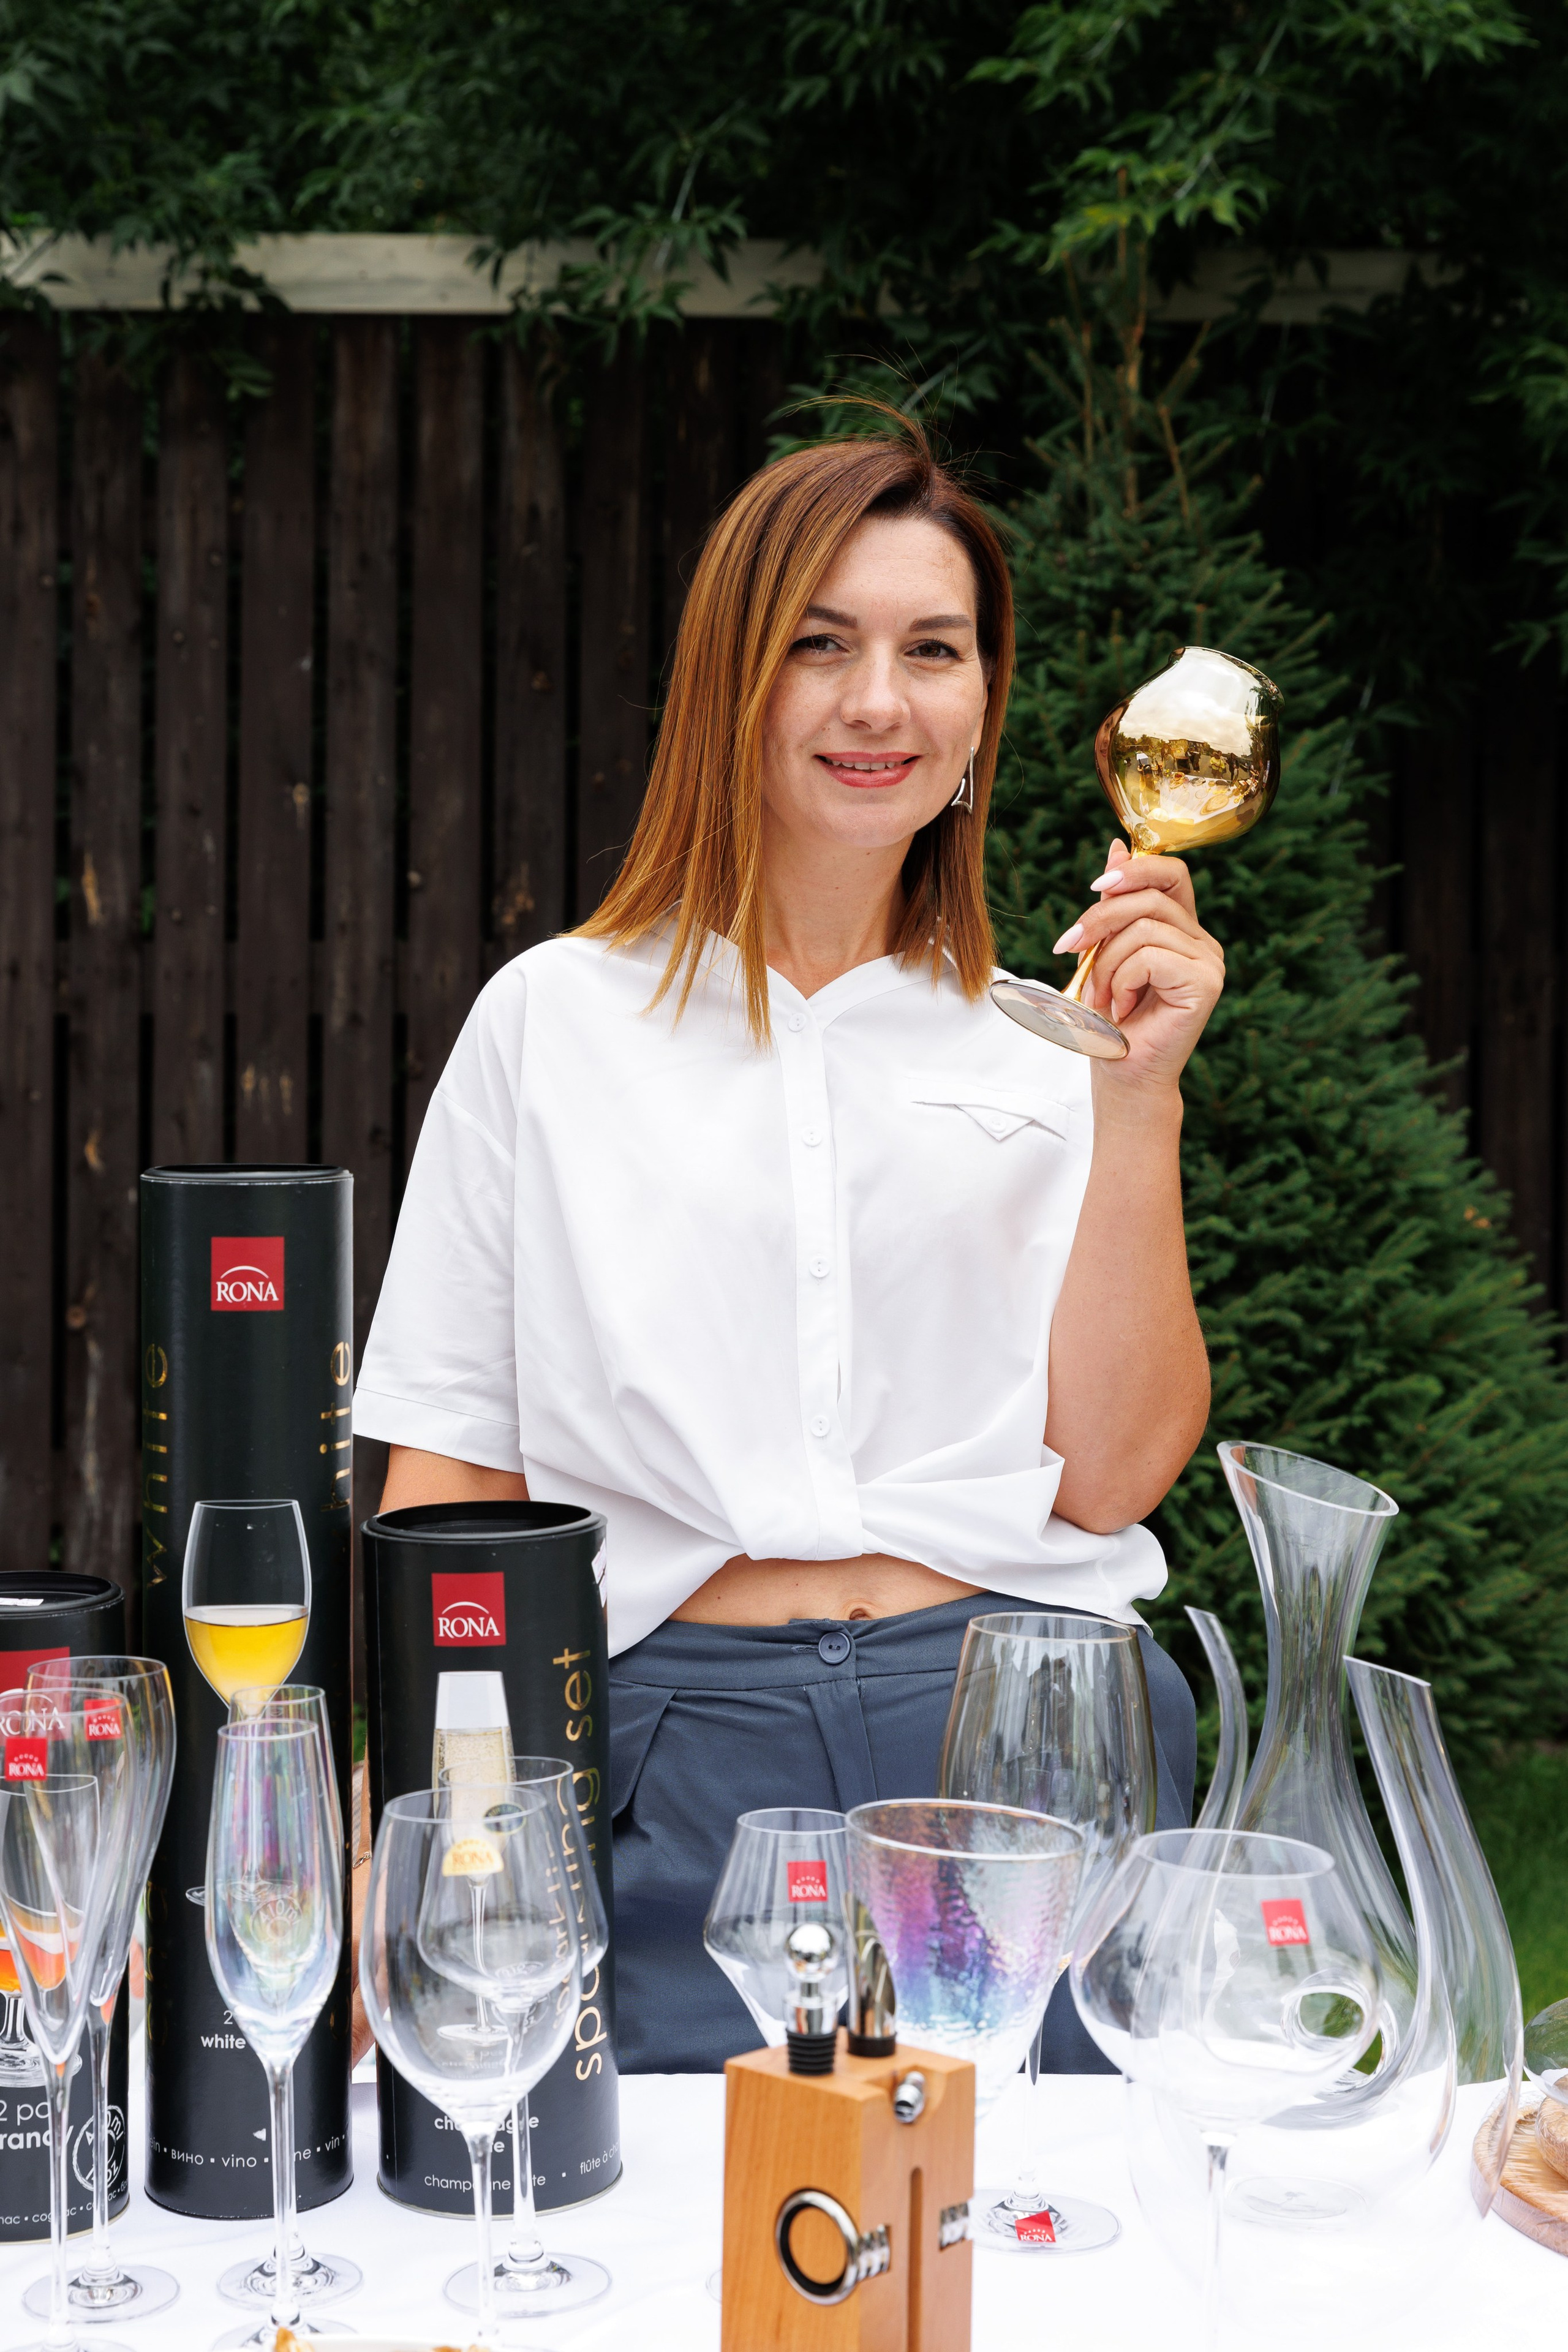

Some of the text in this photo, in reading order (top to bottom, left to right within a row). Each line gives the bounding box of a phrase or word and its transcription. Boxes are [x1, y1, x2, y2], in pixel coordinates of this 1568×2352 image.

[216, 1281, 279, 1303] RONA
[320, 1341, 350, 1513] hite
[438, 1616, 500, 1638] RONA
[552, 1647, 593, 1742] set
[88, 1722, 121, 1737] RONA
[9, 1762, 44, 1777] RONA
[791, 1884, 826, 1898] RONA
[1268, 1925, 1307, 1942] RONA
[224, 2010, 233, 2024] 2
[201, 2034, 246, 2049] white
[172, 2149, 204, 2165] вино
[222, 2154, 257, 2168] vino
[325, 2136, 339, 2151] vin
[580, 2158, 601, 2175] flûte
[603, 2150, 608, 2163] à
